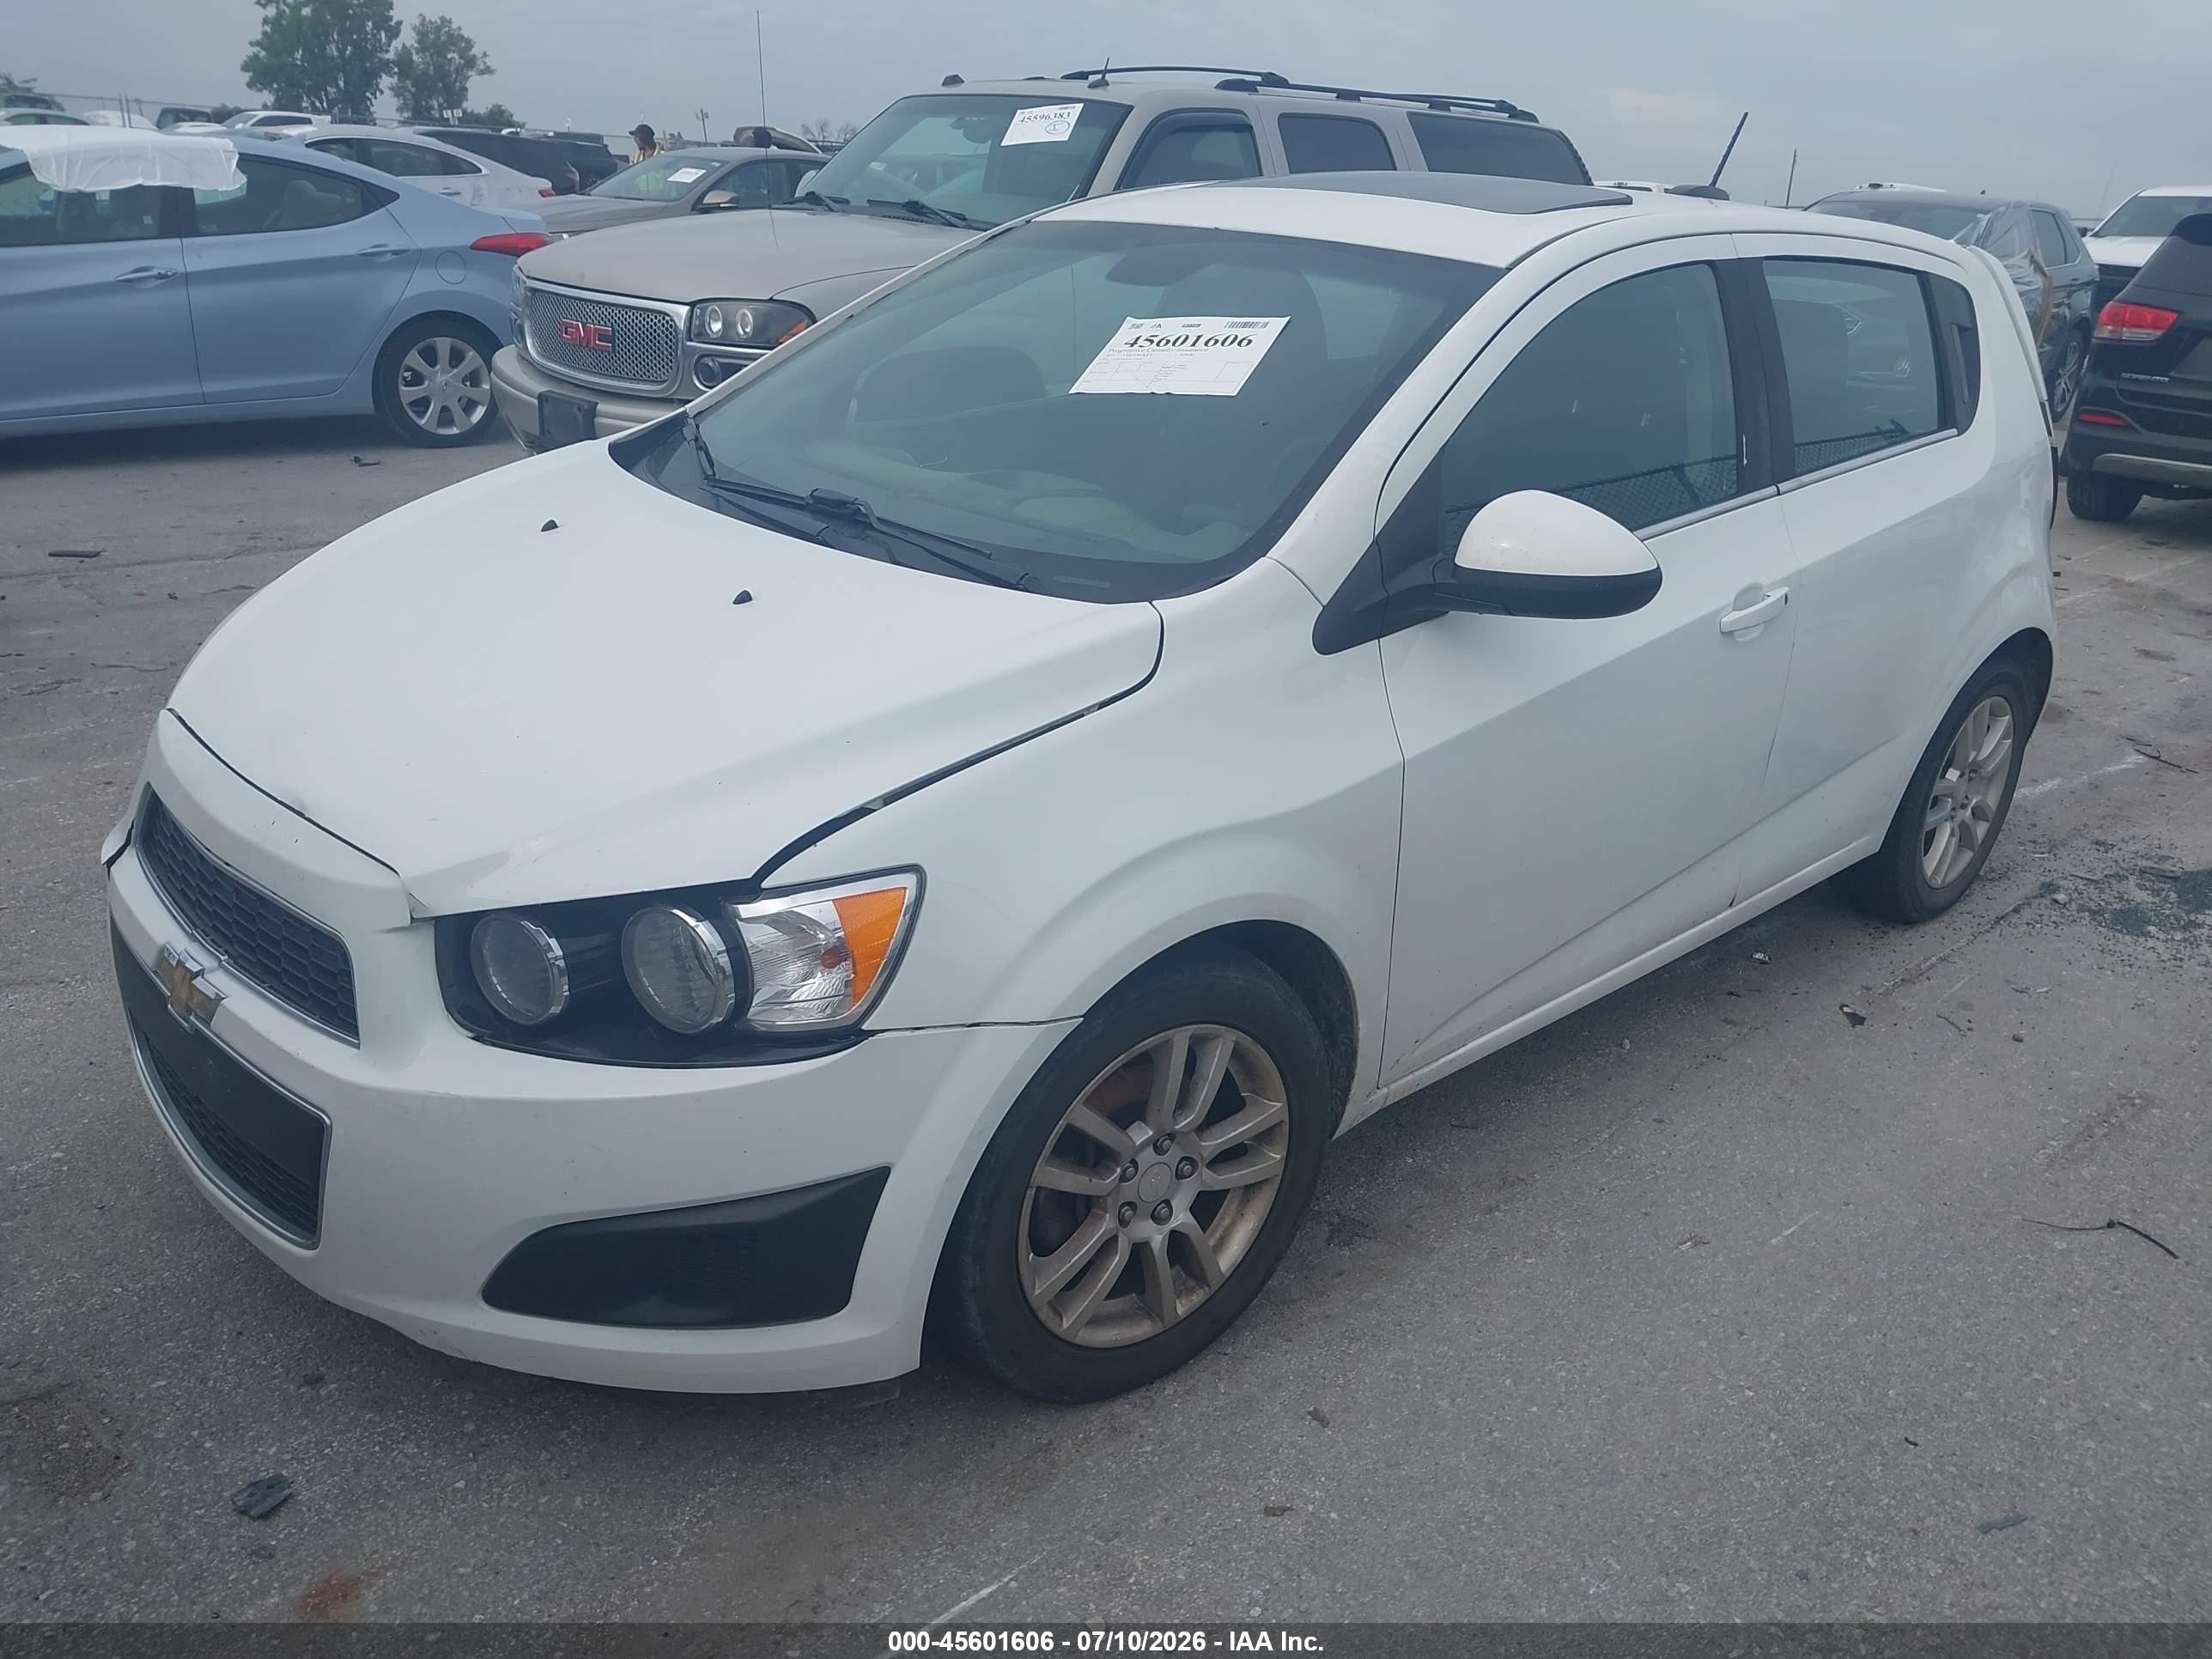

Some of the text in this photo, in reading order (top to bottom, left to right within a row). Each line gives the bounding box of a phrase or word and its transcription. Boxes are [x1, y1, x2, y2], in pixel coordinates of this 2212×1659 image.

[1019, 112, 1071, 123] 45596383
[560, 319, 614, 353] GMC
[1124, 332, 1257, 348] 45601606
